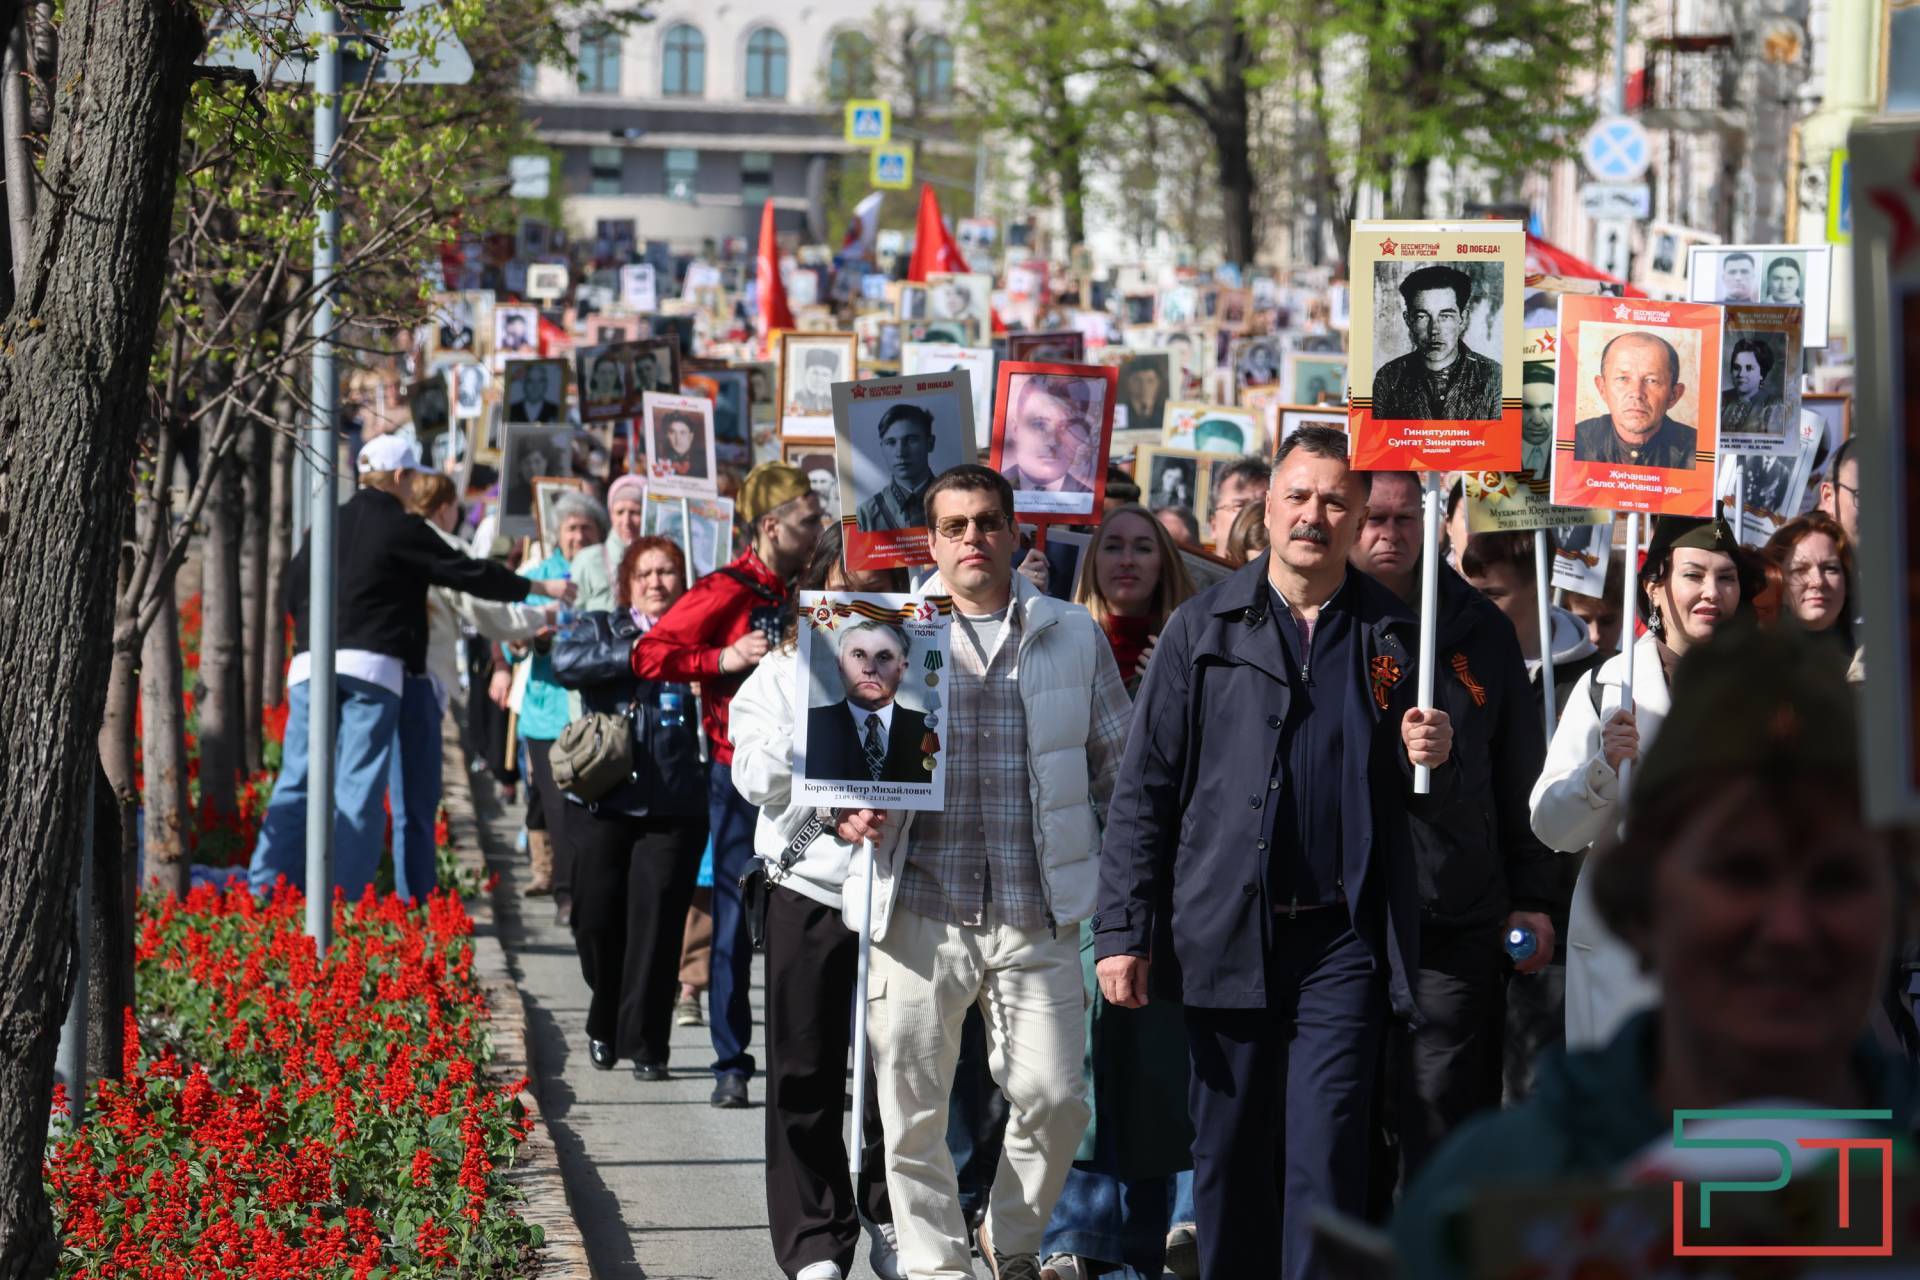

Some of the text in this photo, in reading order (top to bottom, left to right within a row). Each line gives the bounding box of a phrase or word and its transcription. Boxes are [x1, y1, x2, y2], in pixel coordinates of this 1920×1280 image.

[1456, 244, 1501, 254] 80 ПОБЕДА!
[1403, 427, 1470, 437] Гиниятуллин
[1388, 438, 1485, 447] Сунгат Зиннатович
[1586, 478, 1616, 488] Салих
[804, 783, 932, 795] Королев Петр Михайлович
